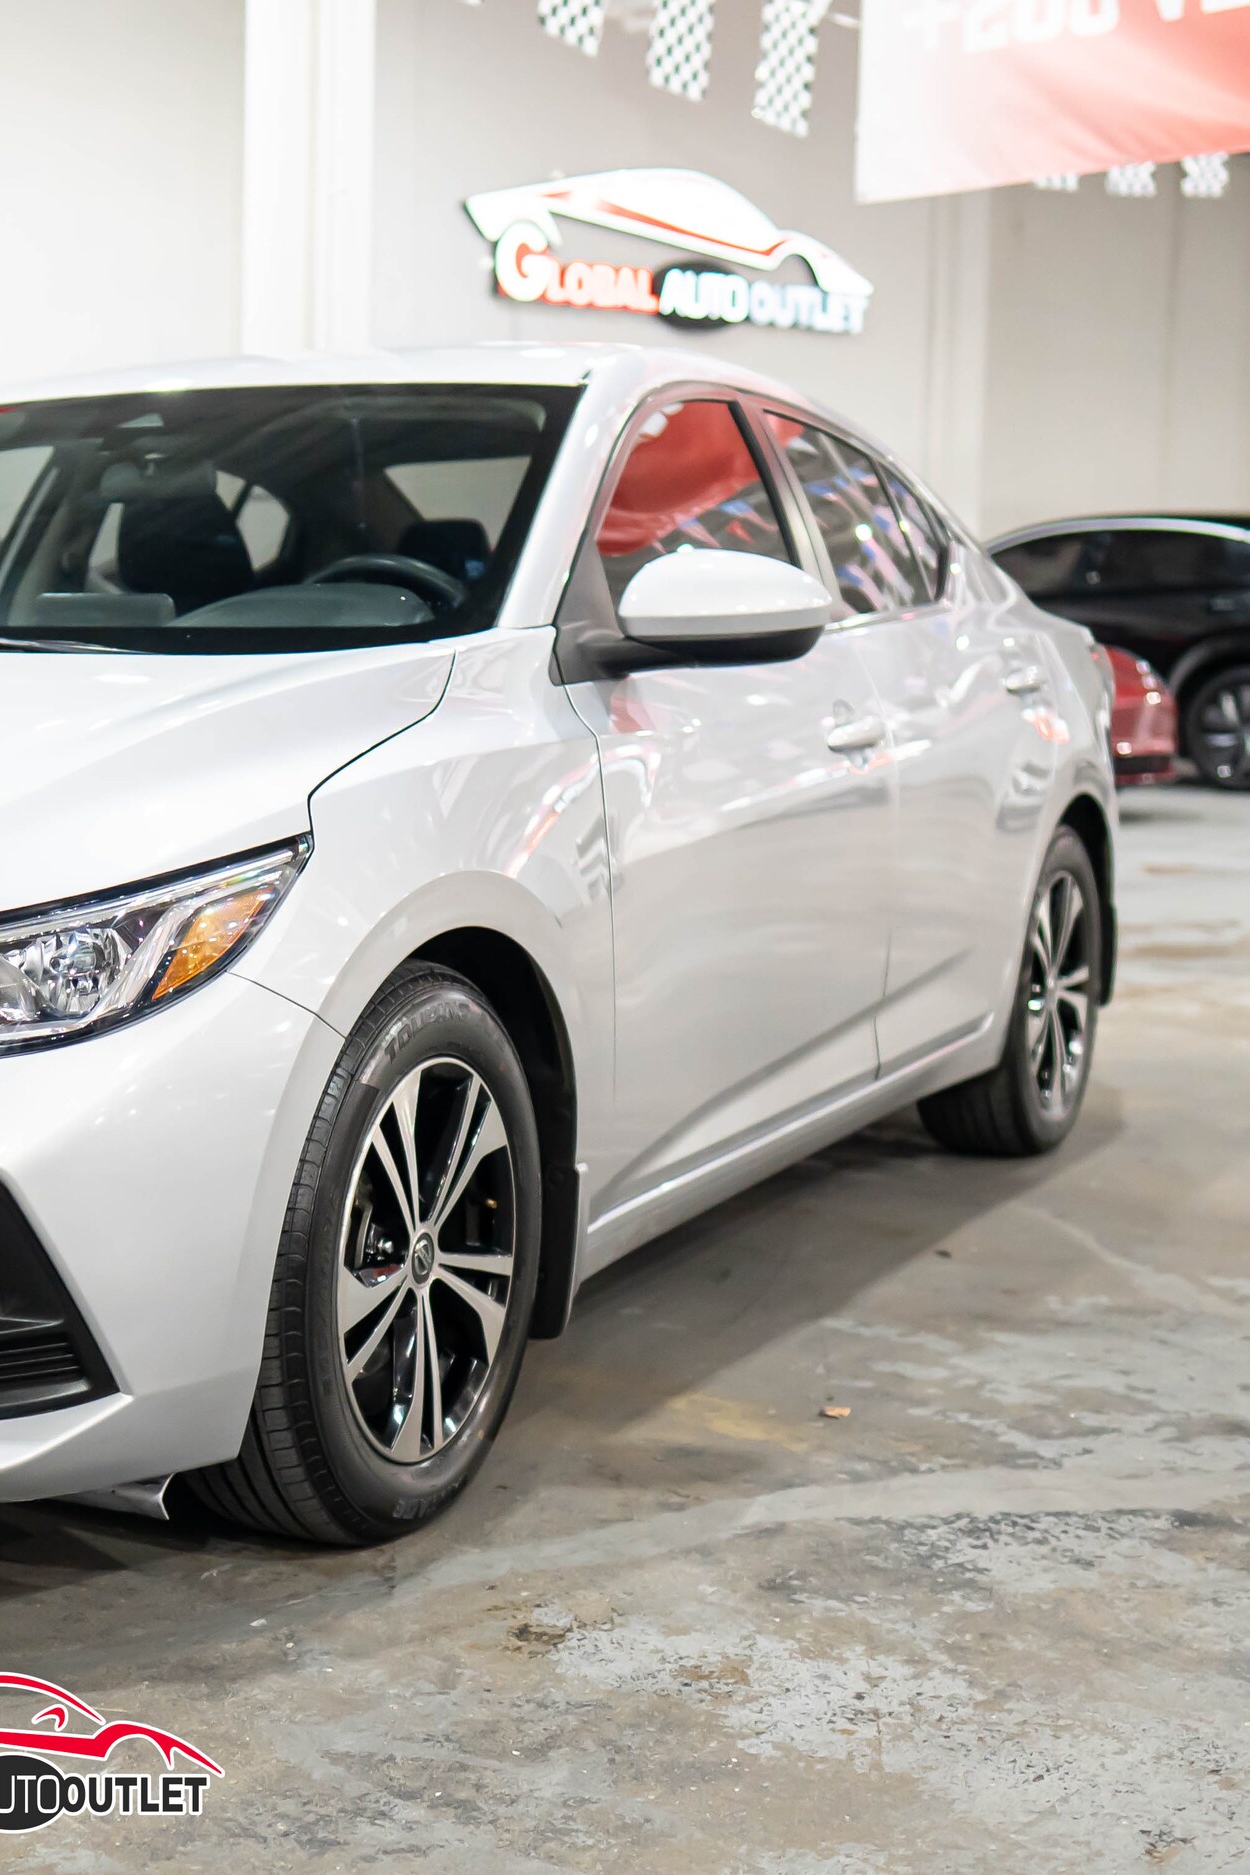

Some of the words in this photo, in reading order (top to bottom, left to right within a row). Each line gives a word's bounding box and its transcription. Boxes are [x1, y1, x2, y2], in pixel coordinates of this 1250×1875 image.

[495, 219, 660, 315] GLOBAL
[660, 267, 750, 323] AUTO
[750, 280, 868, 334] OUTLET
